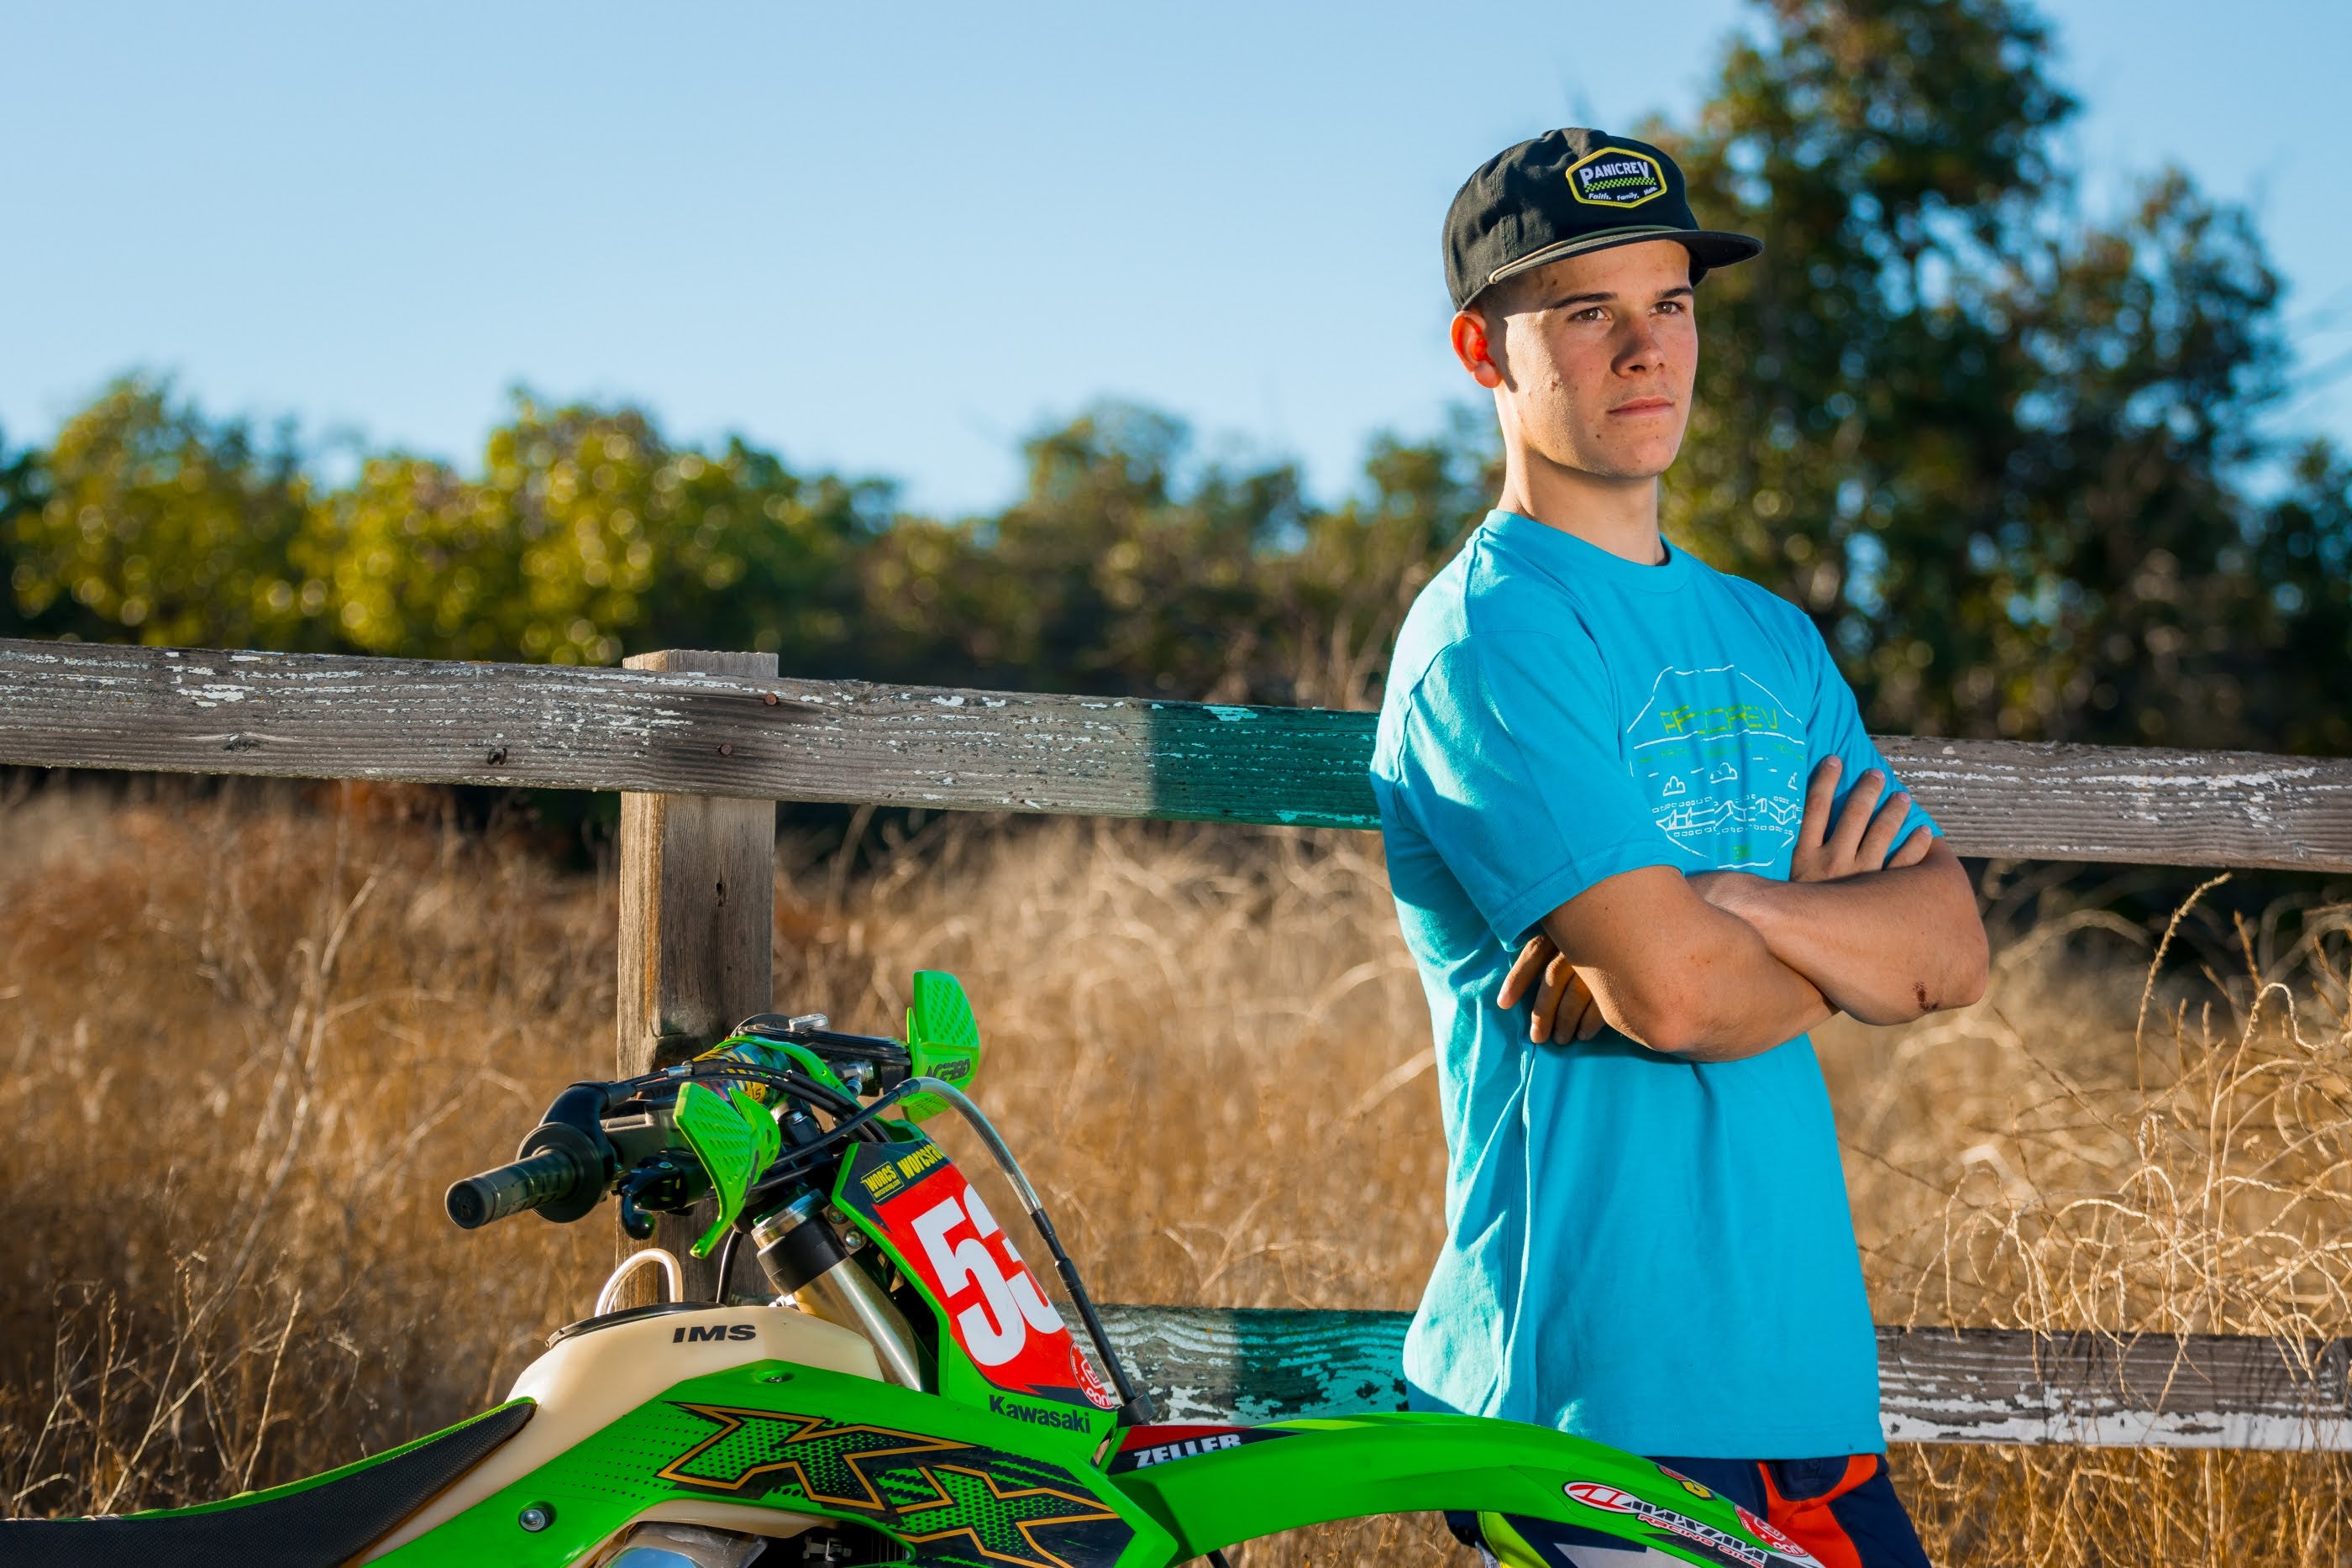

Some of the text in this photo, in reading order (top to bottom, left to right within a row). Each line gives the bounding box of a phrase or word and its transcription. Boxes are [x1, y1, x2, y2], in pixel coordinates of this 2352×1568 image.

[1579, 161, 1650, 186] PANICREV
[860, 1165, 897, 1192] WORCS
[672, 1324, 757, 1344] IMS
[989, 1394, 1091, 1434] Kawasaki
[1134, 1434, 1242, 1469] ZELLER
[1638, 1513, 1714, 1547] RACING
[1719, 1544, 1764, 1568] OILS
